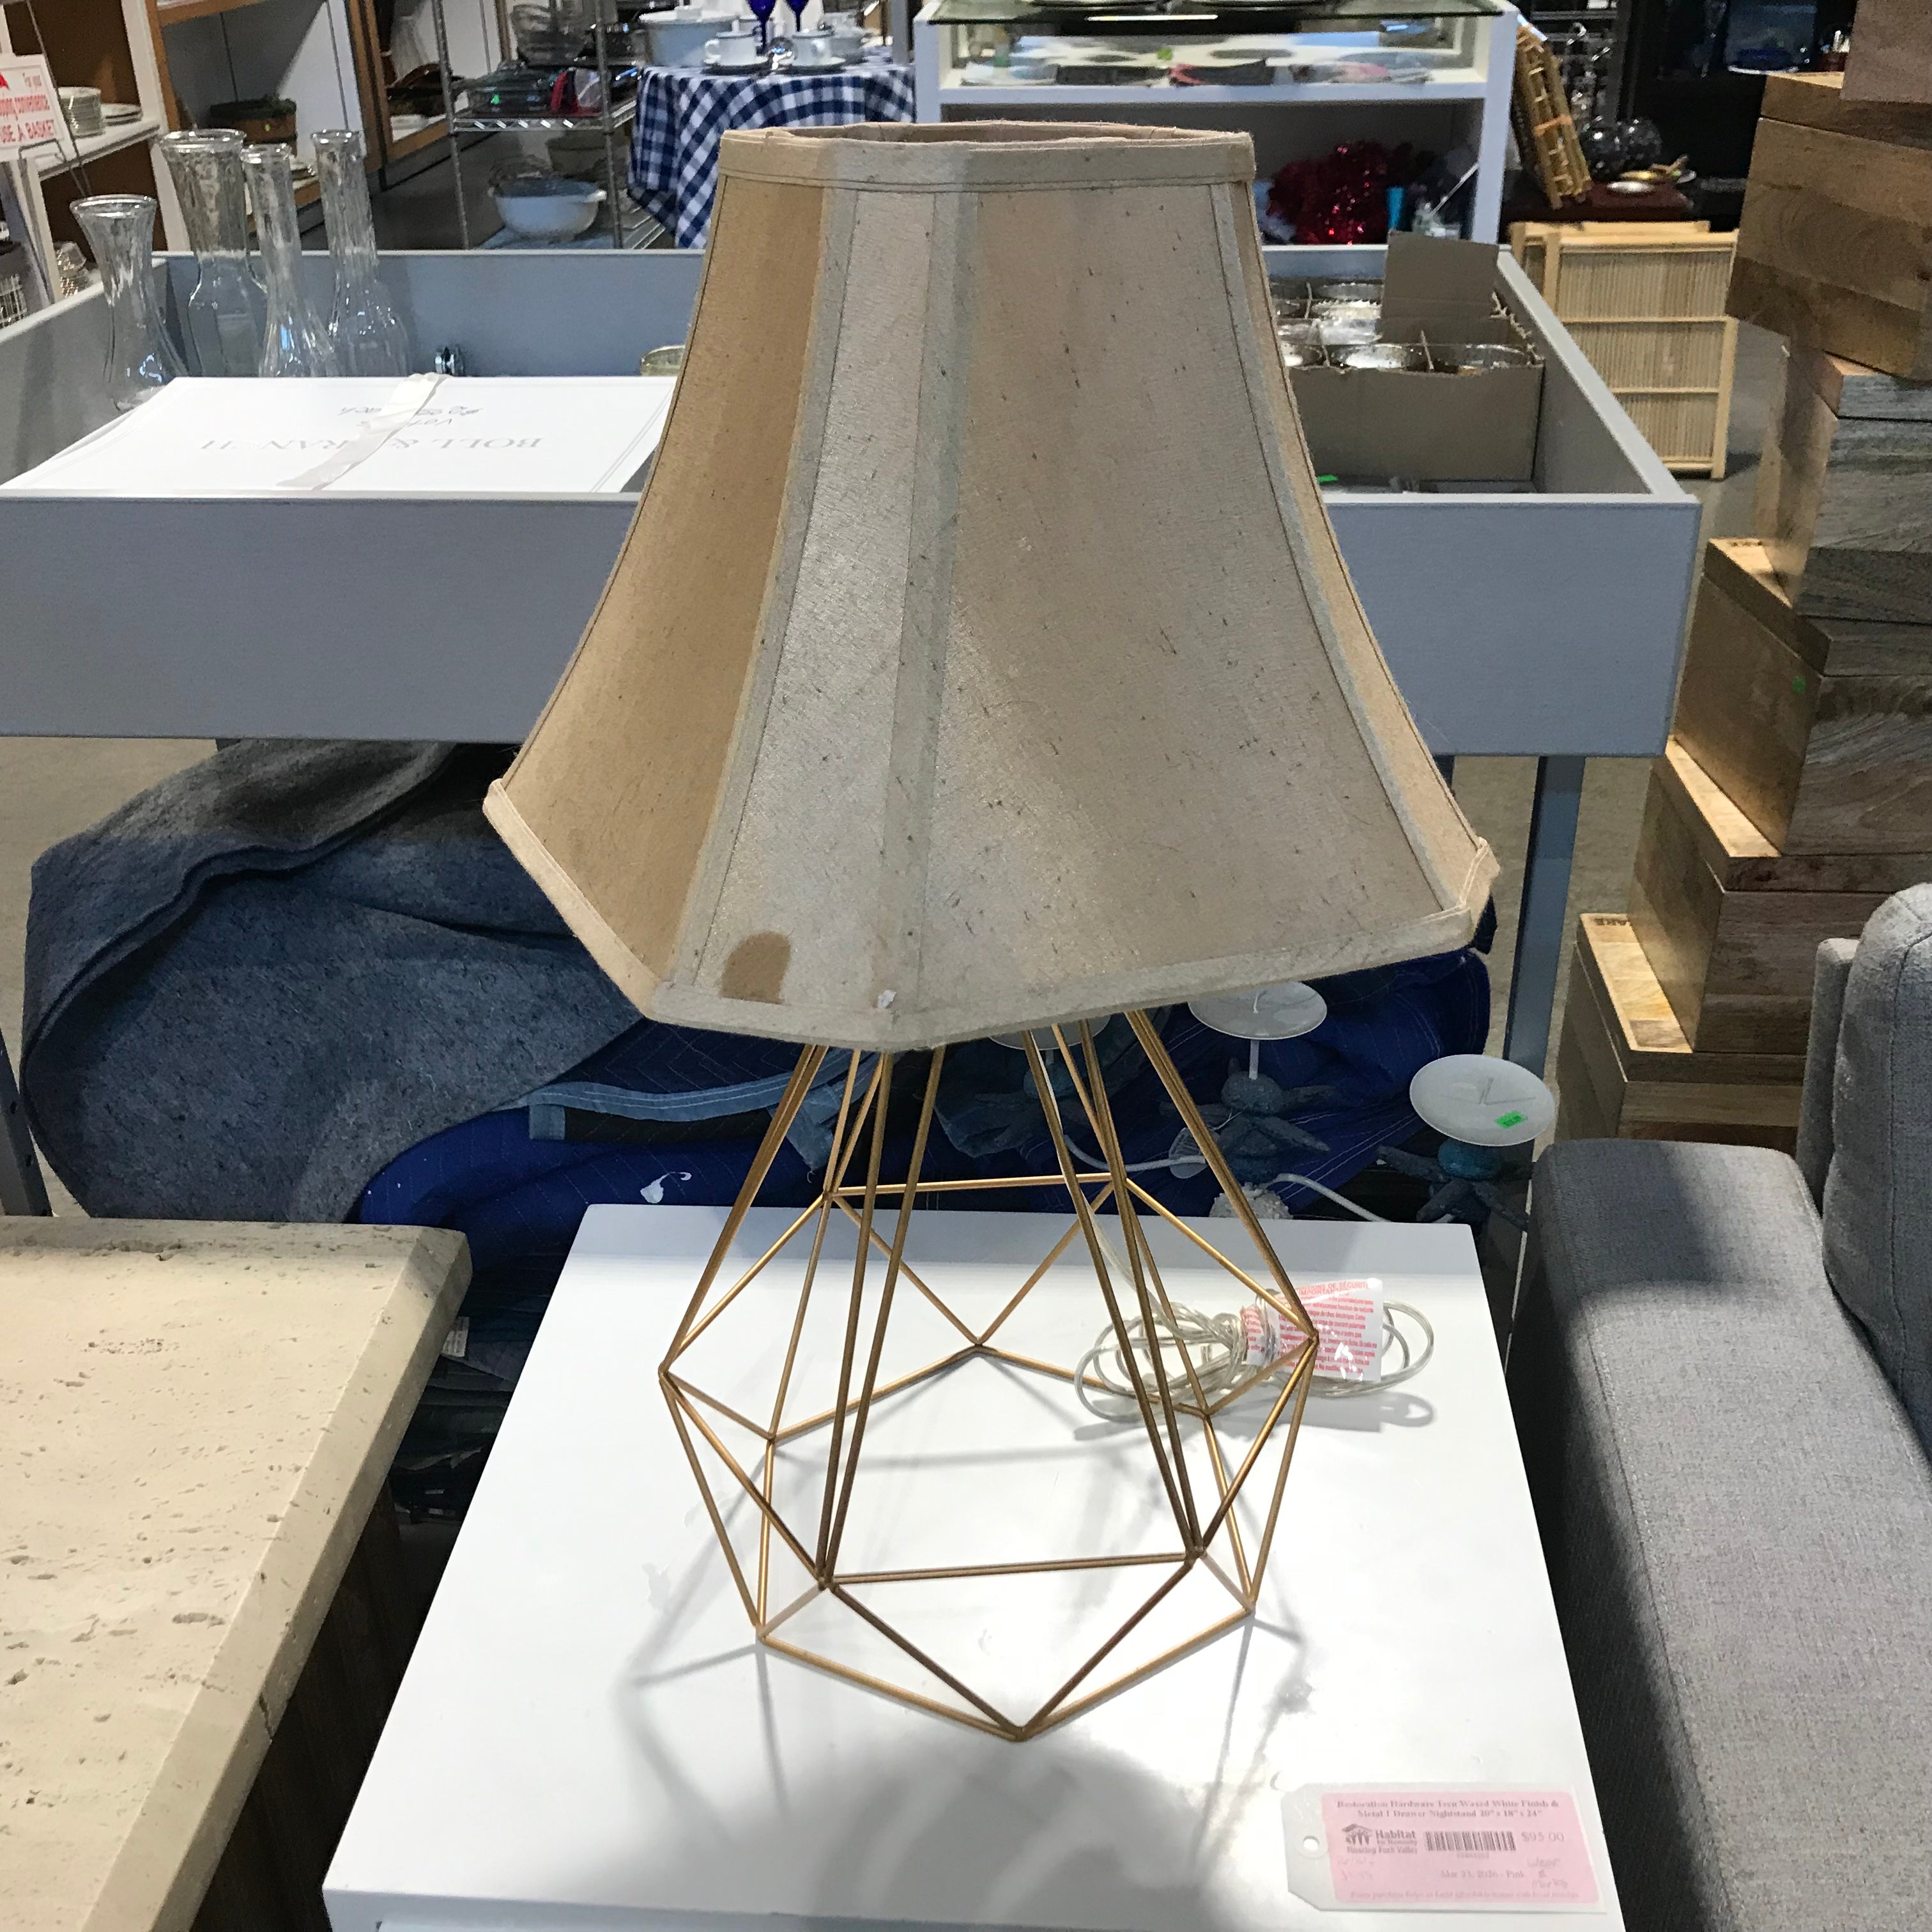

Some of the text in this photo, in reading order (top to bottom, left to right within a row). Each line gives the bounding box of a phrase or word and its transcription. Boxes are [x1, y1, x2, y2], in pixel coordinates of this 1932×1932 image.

[431, 438, 545, 449] BOLL
[1429, 1809, 1477, 1819] Nightstand
[1375, 1829, 1416, 1839] Habitat
[1397, 1846, 1418, 1855] Valley
[1505, 1869, 1524, 1878] Pink
